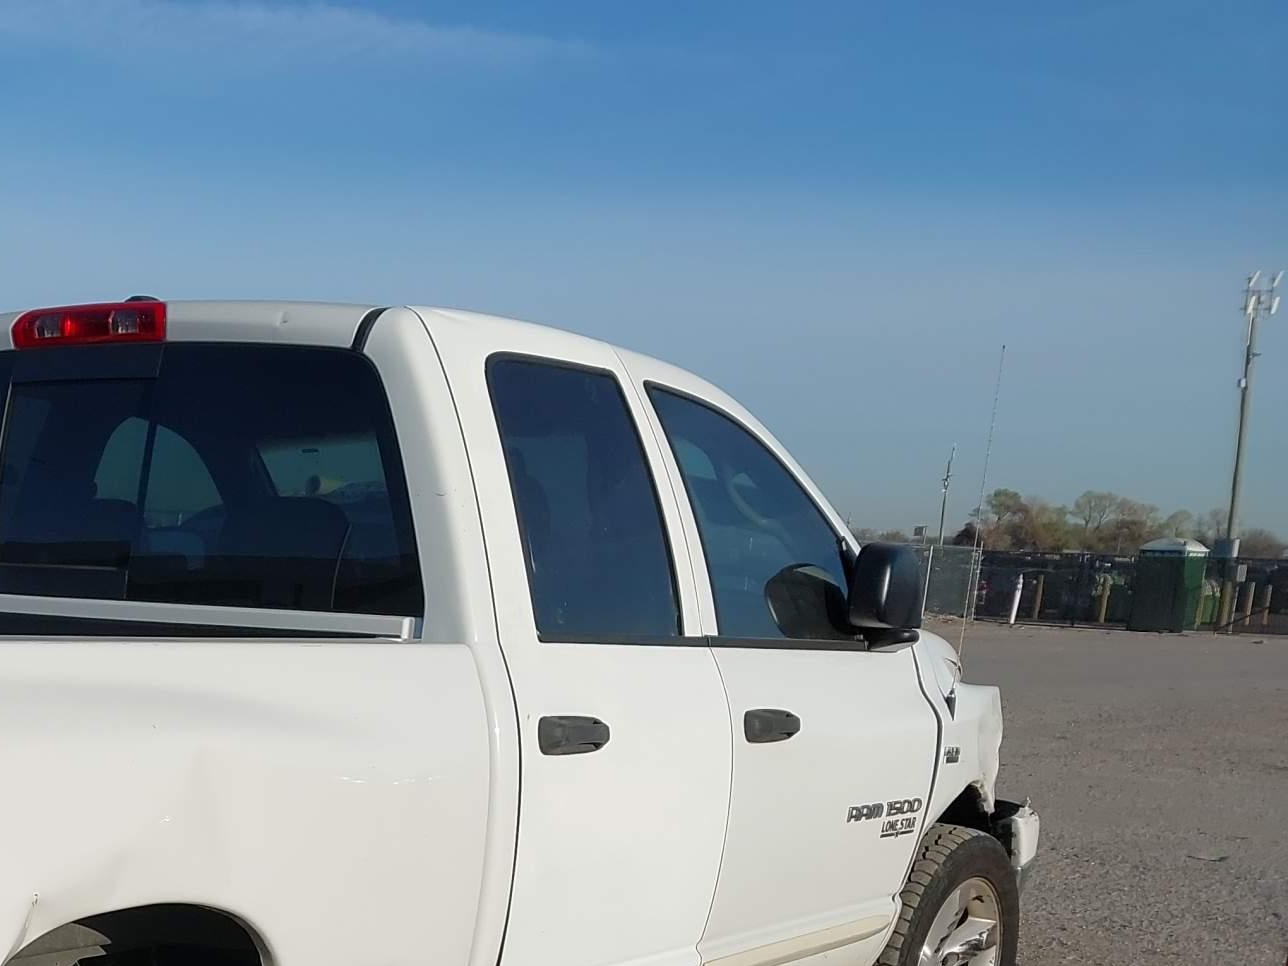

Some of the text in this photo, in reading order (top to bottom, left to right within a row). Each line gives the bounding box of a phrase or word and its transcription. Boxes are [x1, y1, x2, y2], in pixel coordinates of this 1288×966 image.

[847, 797, 922, 823] RAM 1500
[880, 817, 917, 832] LONE STAR
